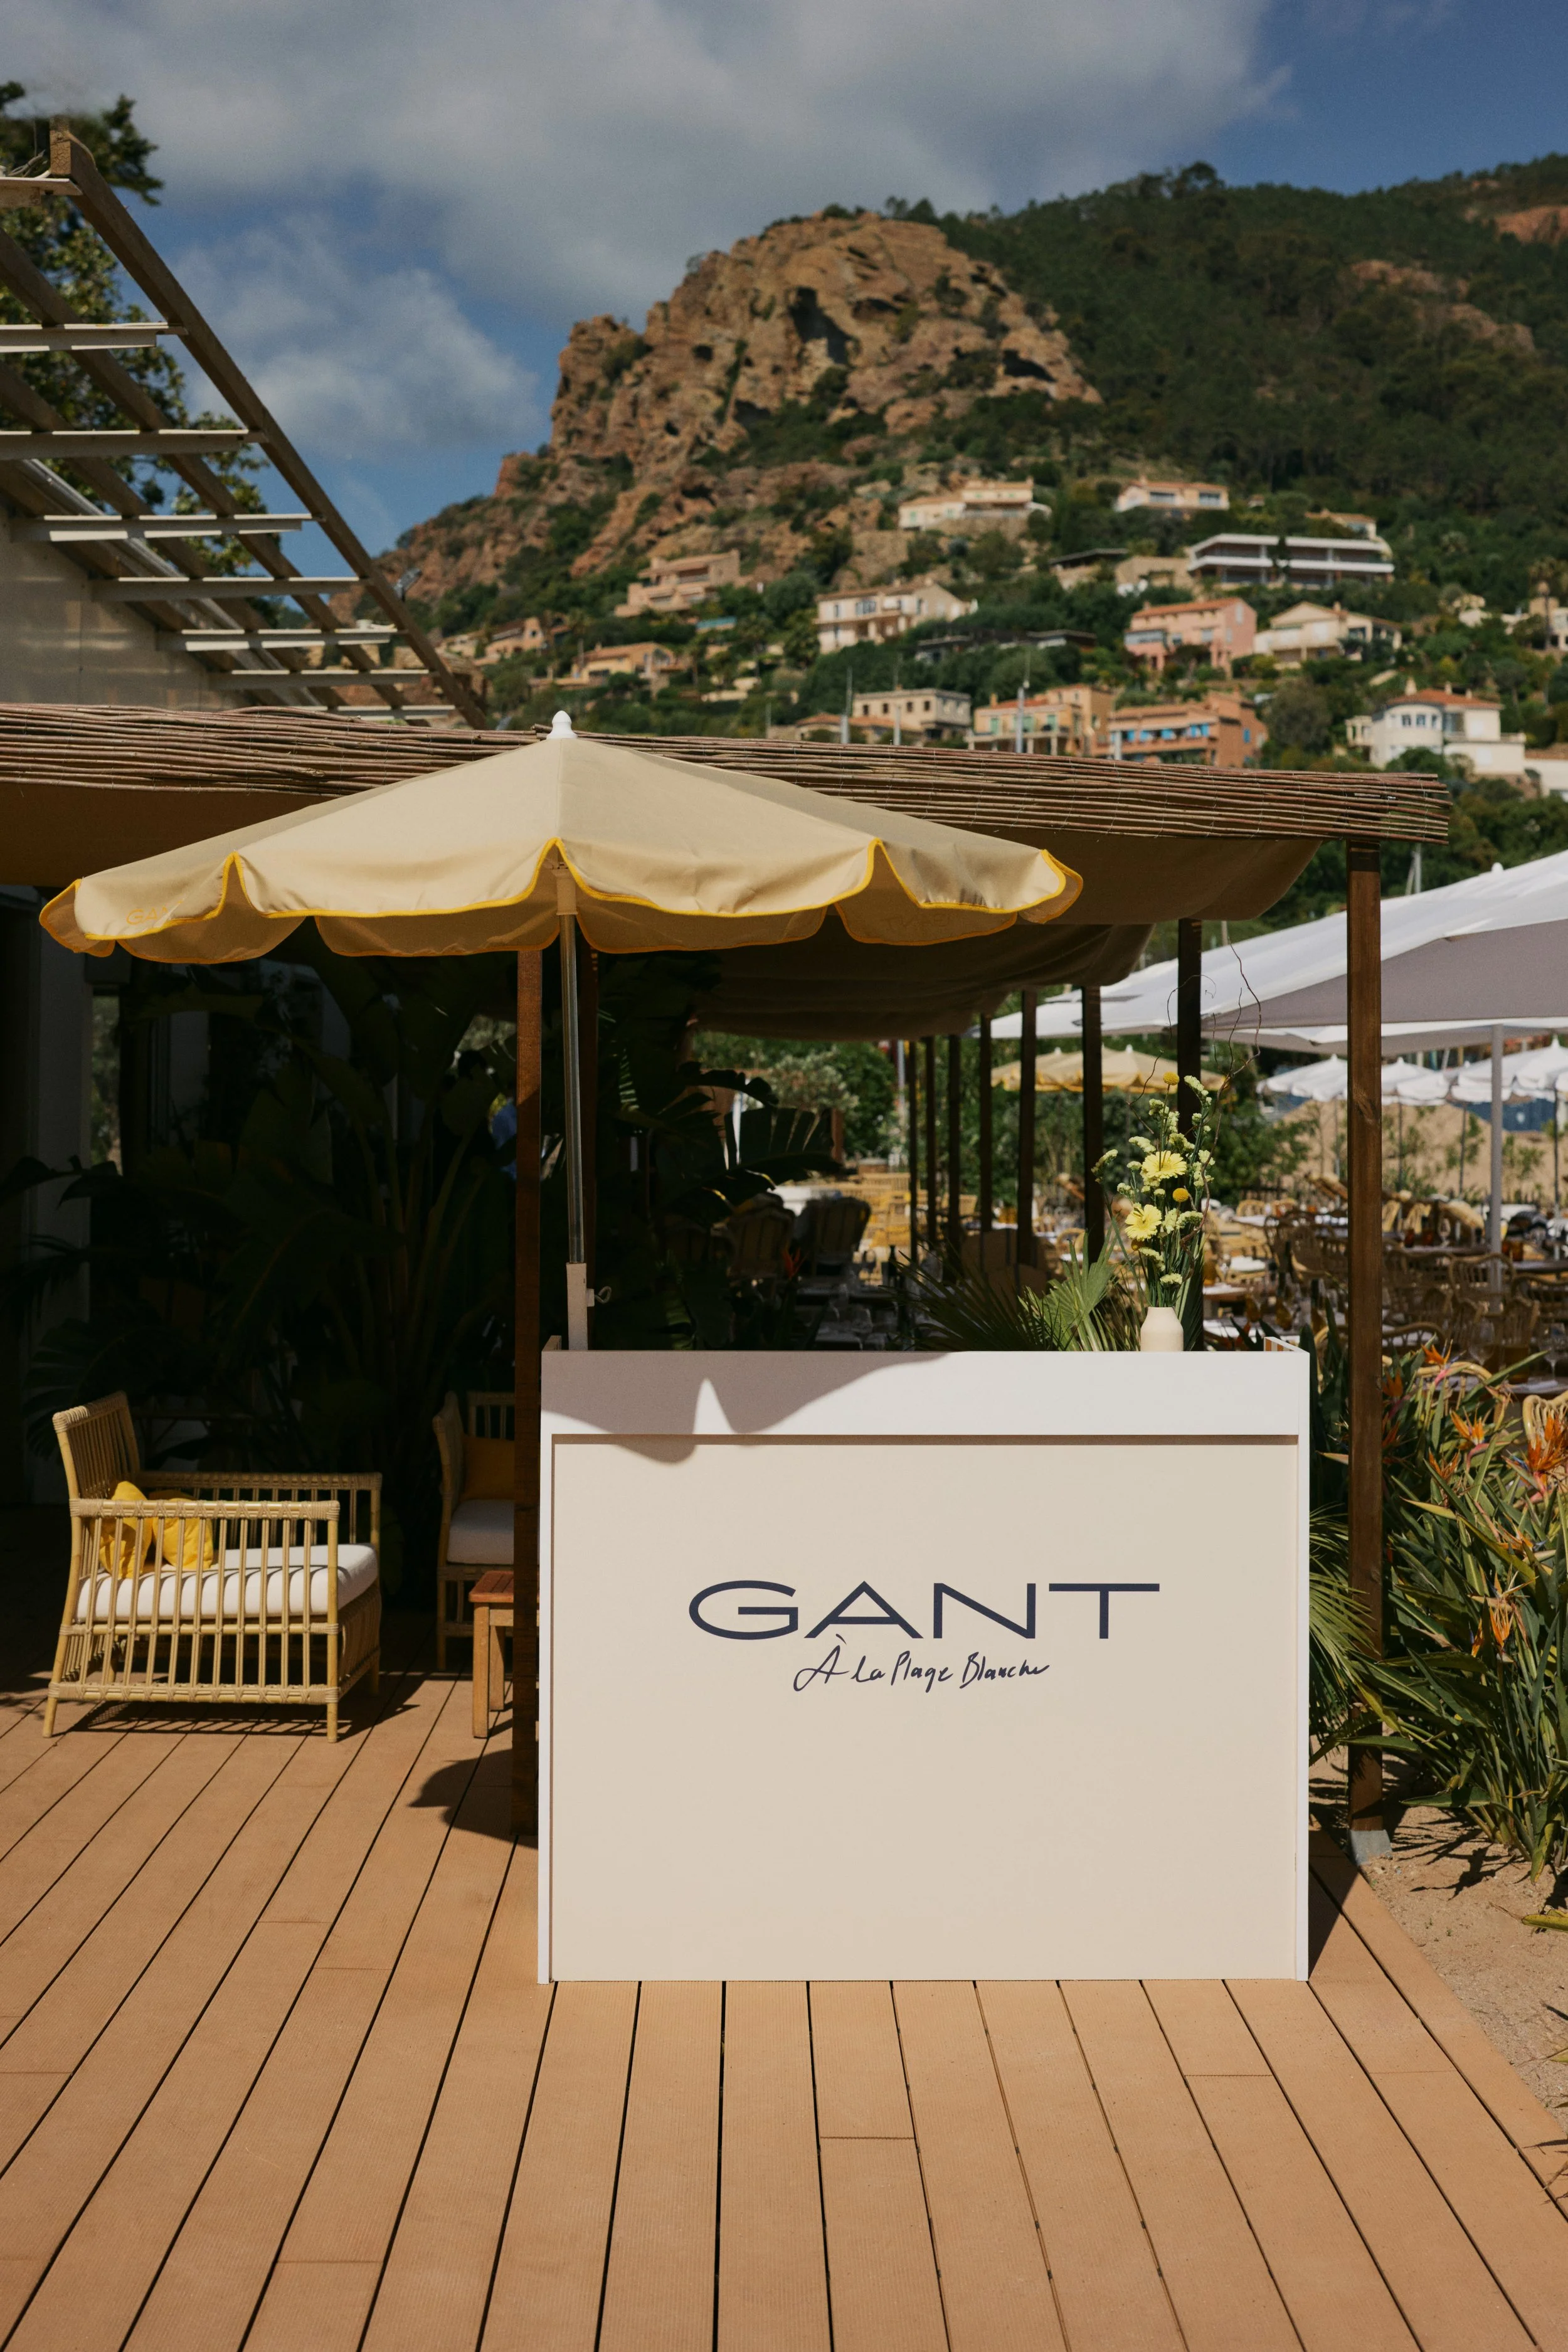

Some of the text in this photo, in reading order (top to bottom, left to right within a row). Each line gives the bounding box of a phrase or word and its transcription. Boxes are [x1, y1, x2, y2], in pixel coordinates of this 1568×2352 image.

[688, 1580, 1160, 1641] GANT
[793, 1633, 849, 1692] À
[890, 1650, 954, 1693] Plage
[959, 1651, 1051, 1689] Blanche
